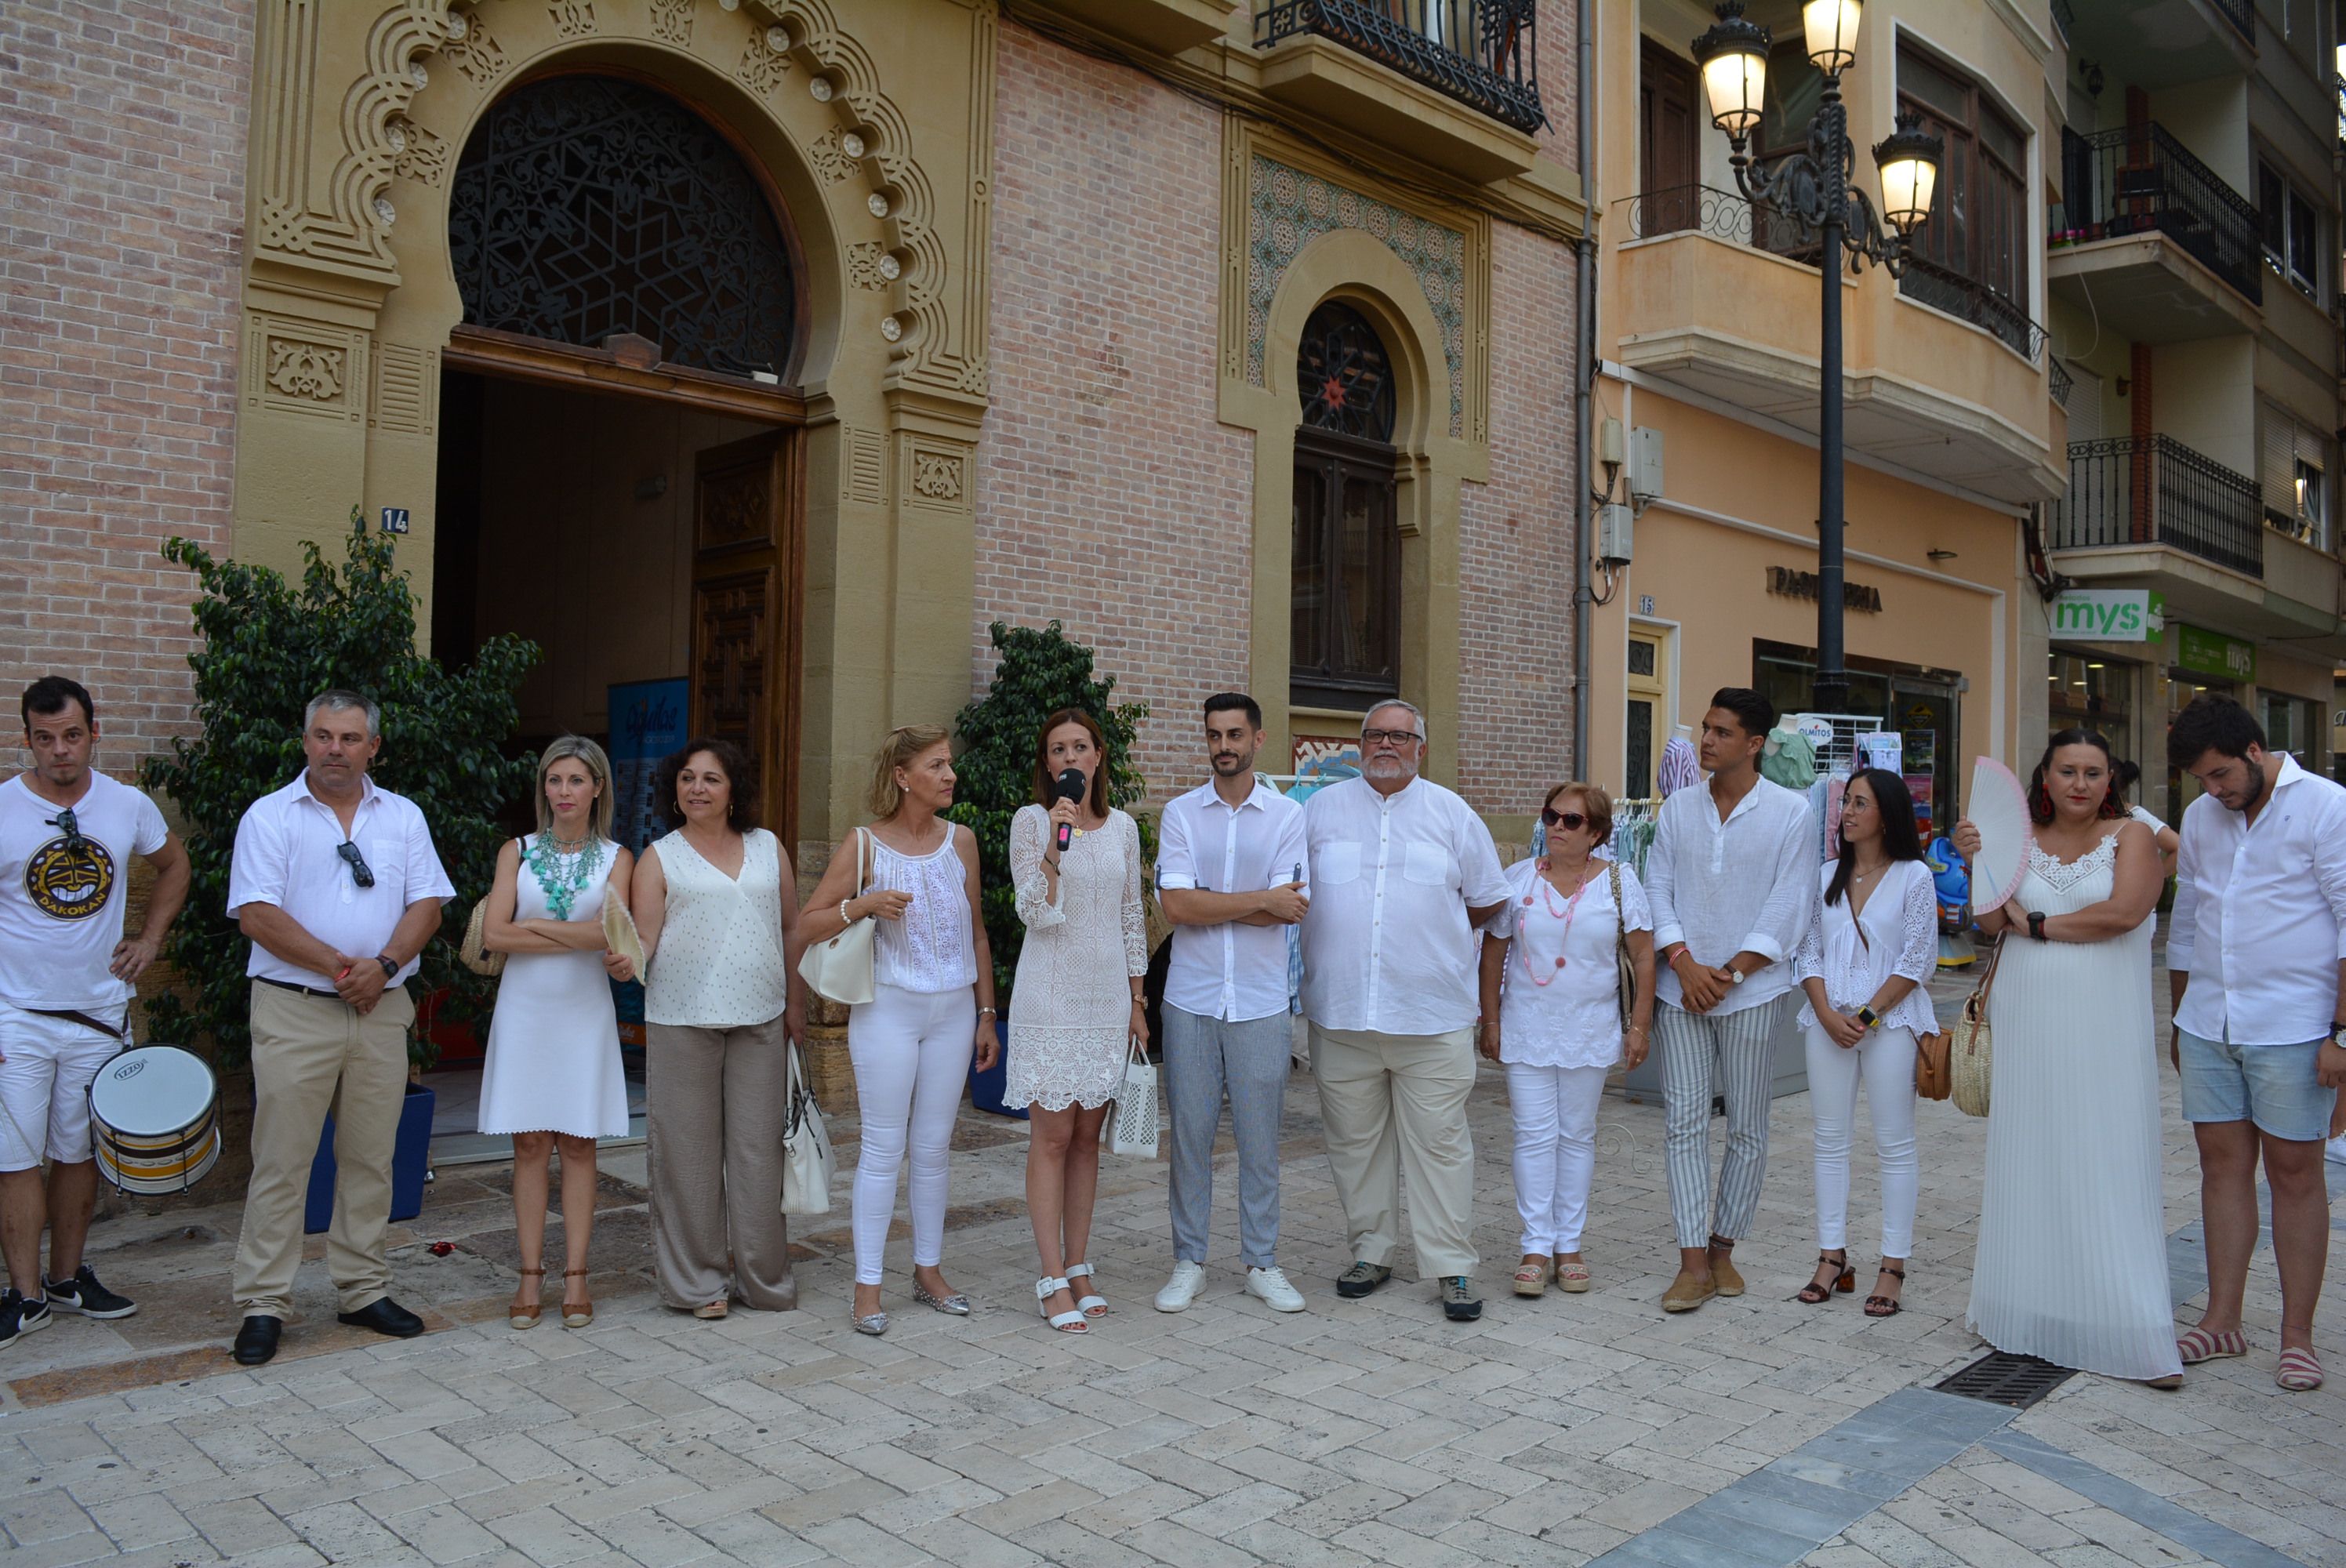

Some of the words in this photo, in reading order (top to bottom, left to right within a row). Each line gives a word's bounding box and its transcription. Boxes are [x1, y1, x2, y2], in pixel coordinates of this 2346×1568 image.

[384, 510, 408, 532] 14
[1642, 597, 1652, 613] 15
[2057, 602, 2140, 635] mys
[118, 1063, 141, 1079] IZZO
